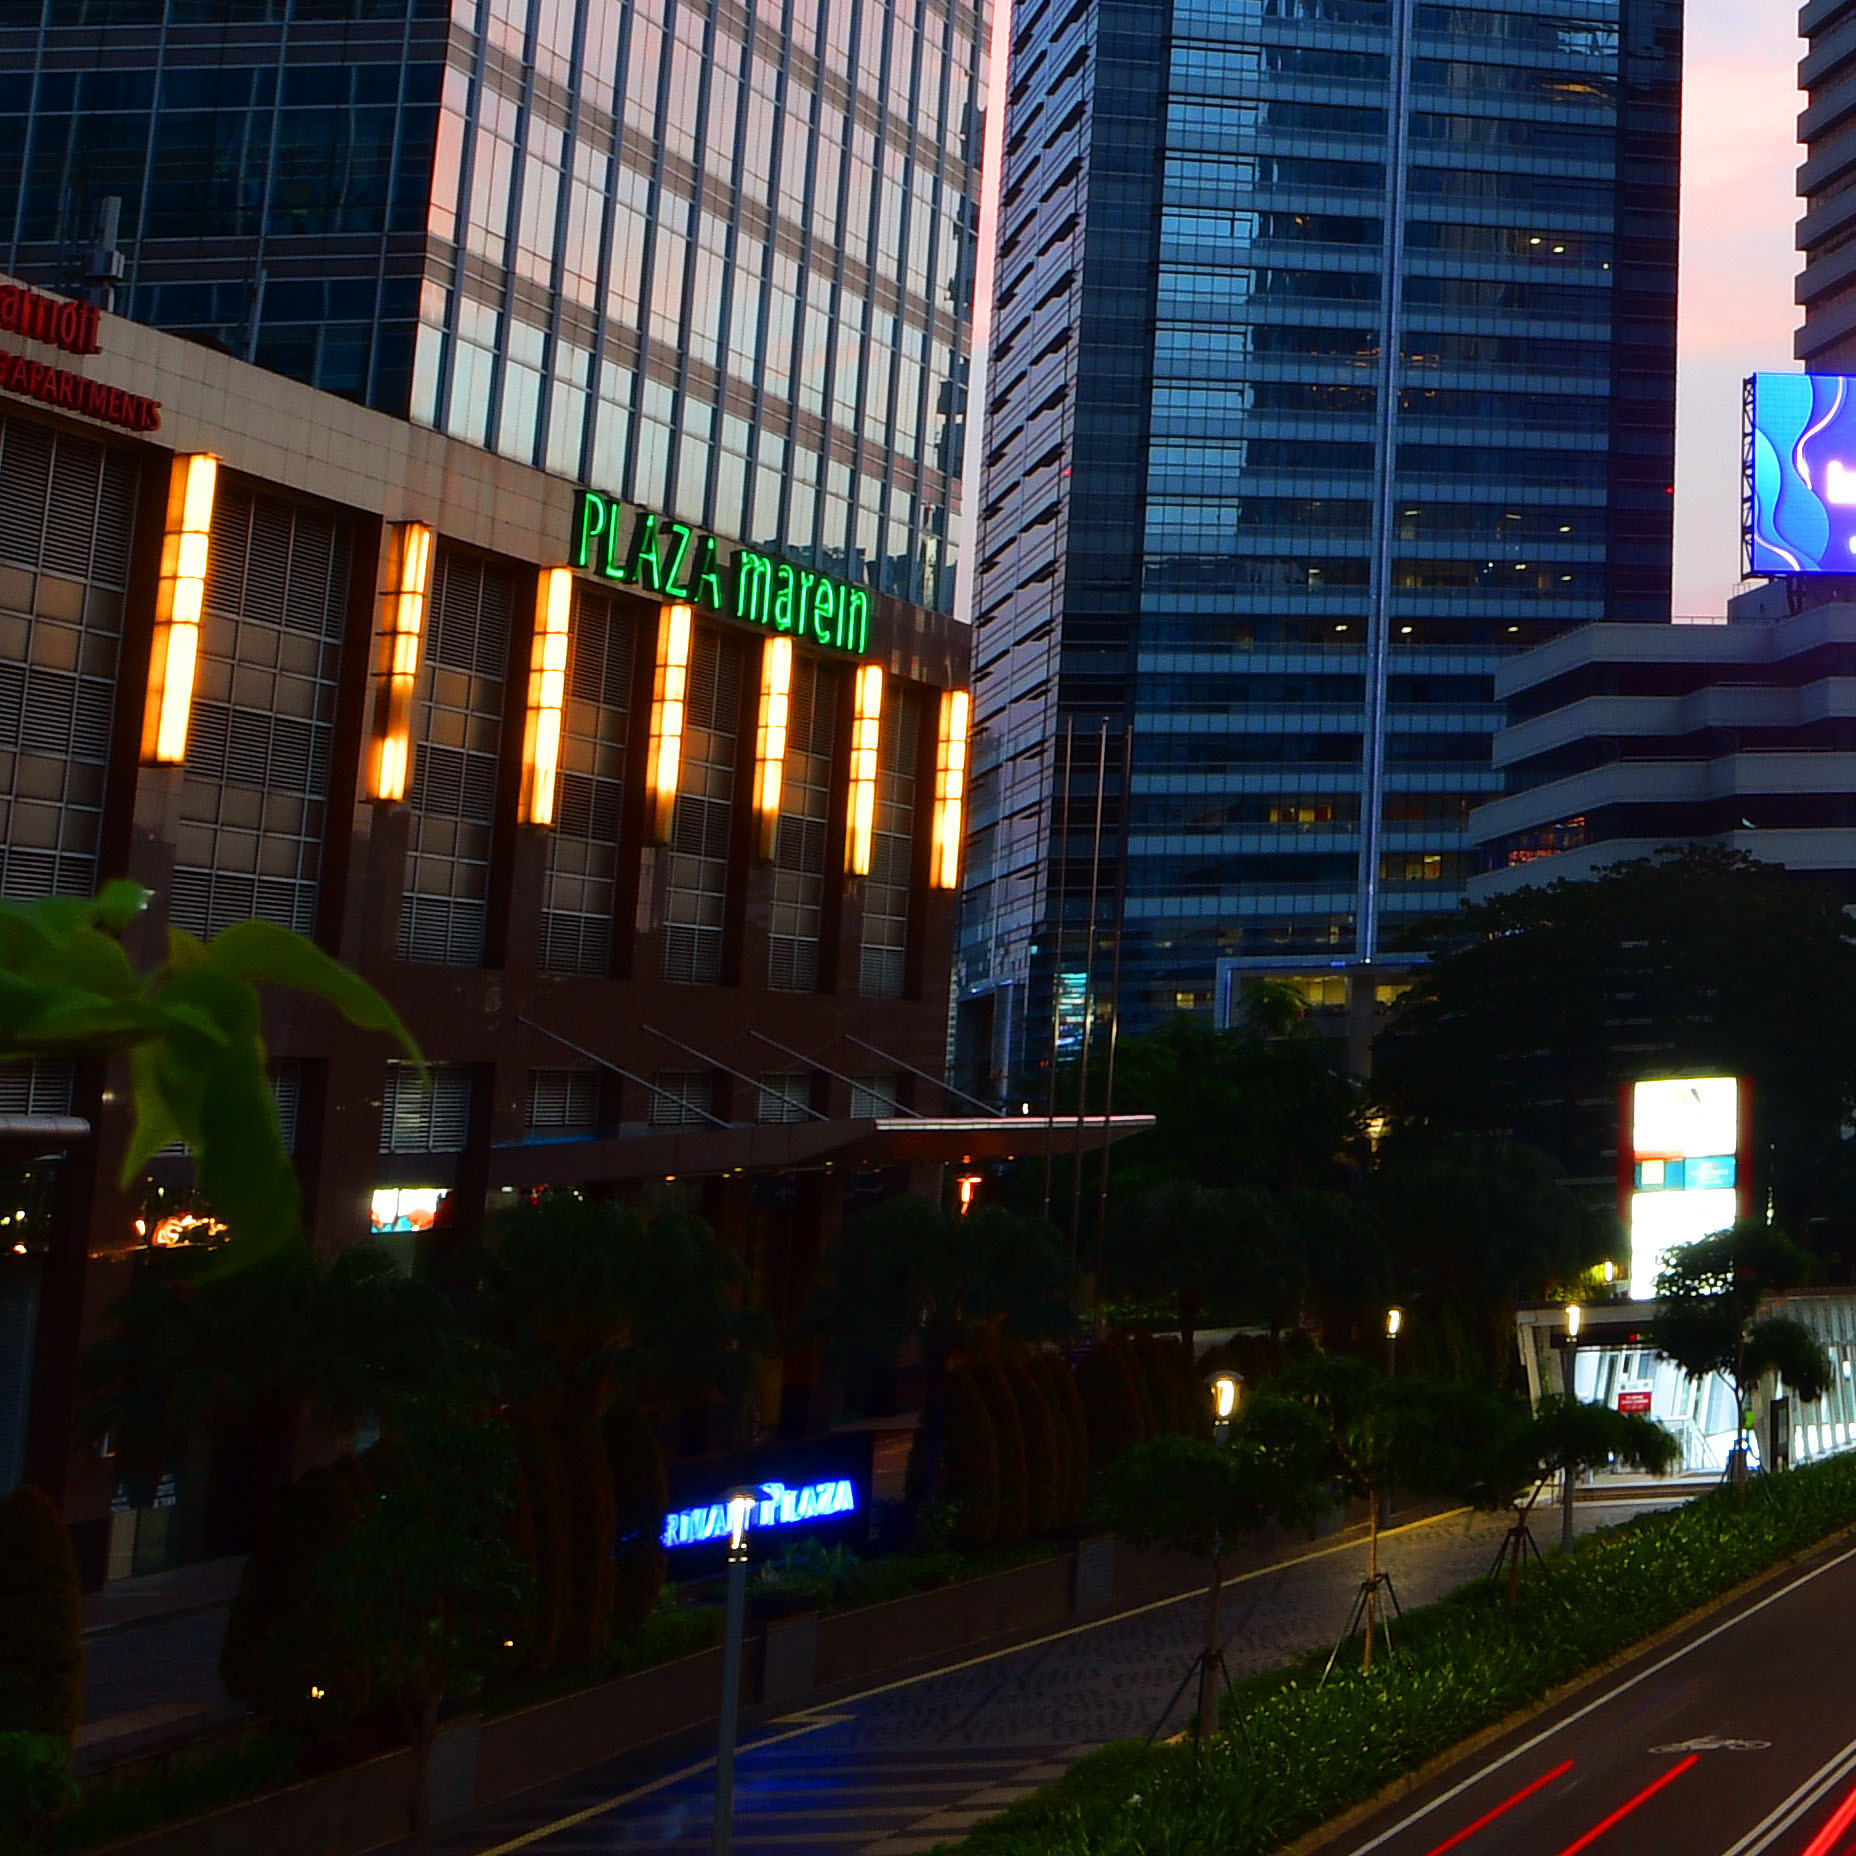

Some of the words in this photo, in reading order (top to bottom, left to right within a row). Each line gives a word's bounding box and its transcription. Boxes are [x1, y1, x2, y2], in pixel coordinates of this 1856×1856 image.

[4, 355, 162, 431] APARTMENTS
[573, 490, 723, 611] PLAZA
[733, 549, 871, 655] marein
[758, 1480, 856, 1527] PLAZA
